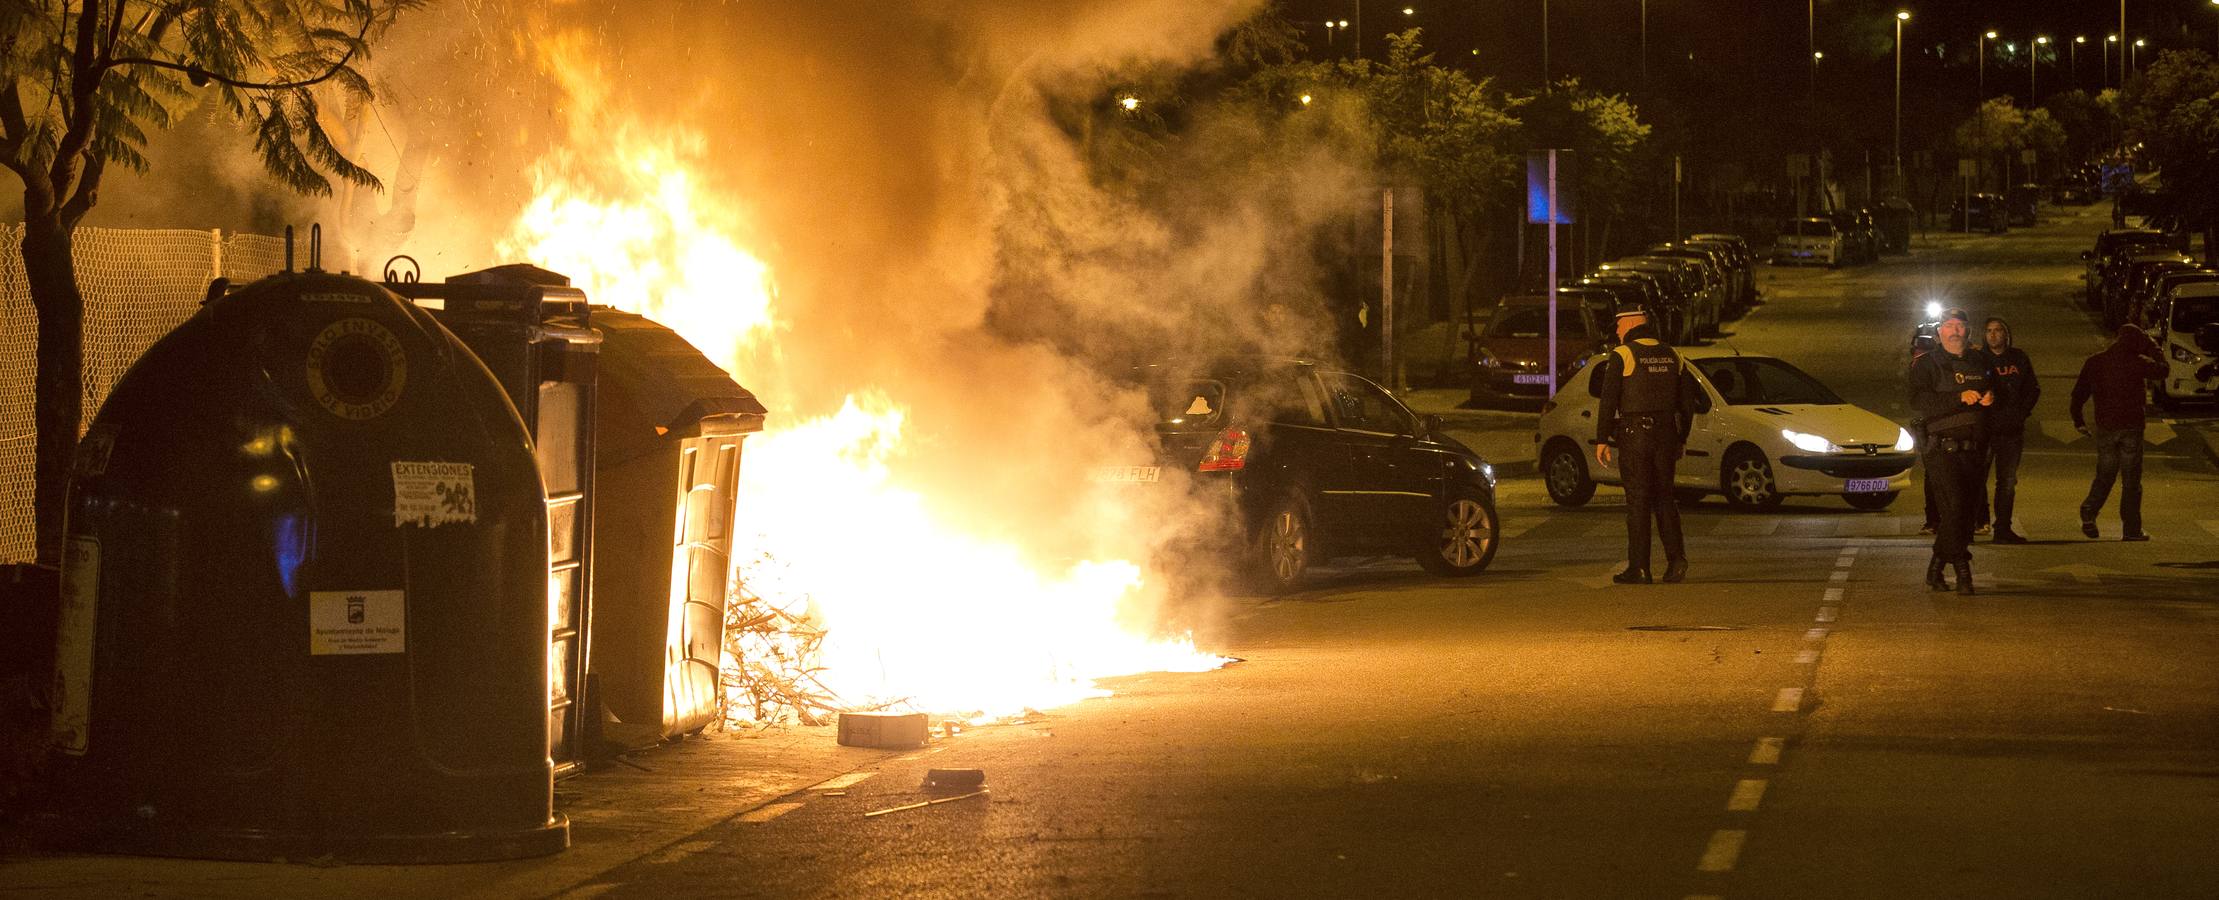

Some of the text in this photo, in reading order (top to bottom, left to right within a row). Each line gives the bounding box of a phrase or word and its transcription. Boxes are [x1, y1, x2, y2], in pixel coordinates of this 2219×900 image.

[308, 321, 405, 369] SOLO ENVASES
[320, 389, 396, 418] DE VIDRIO
[395, 463, 470, 476] EXTENSIONES
[1130, 467, 1155, 480] FLH
[1850, 480, 1871, 491] 9766
